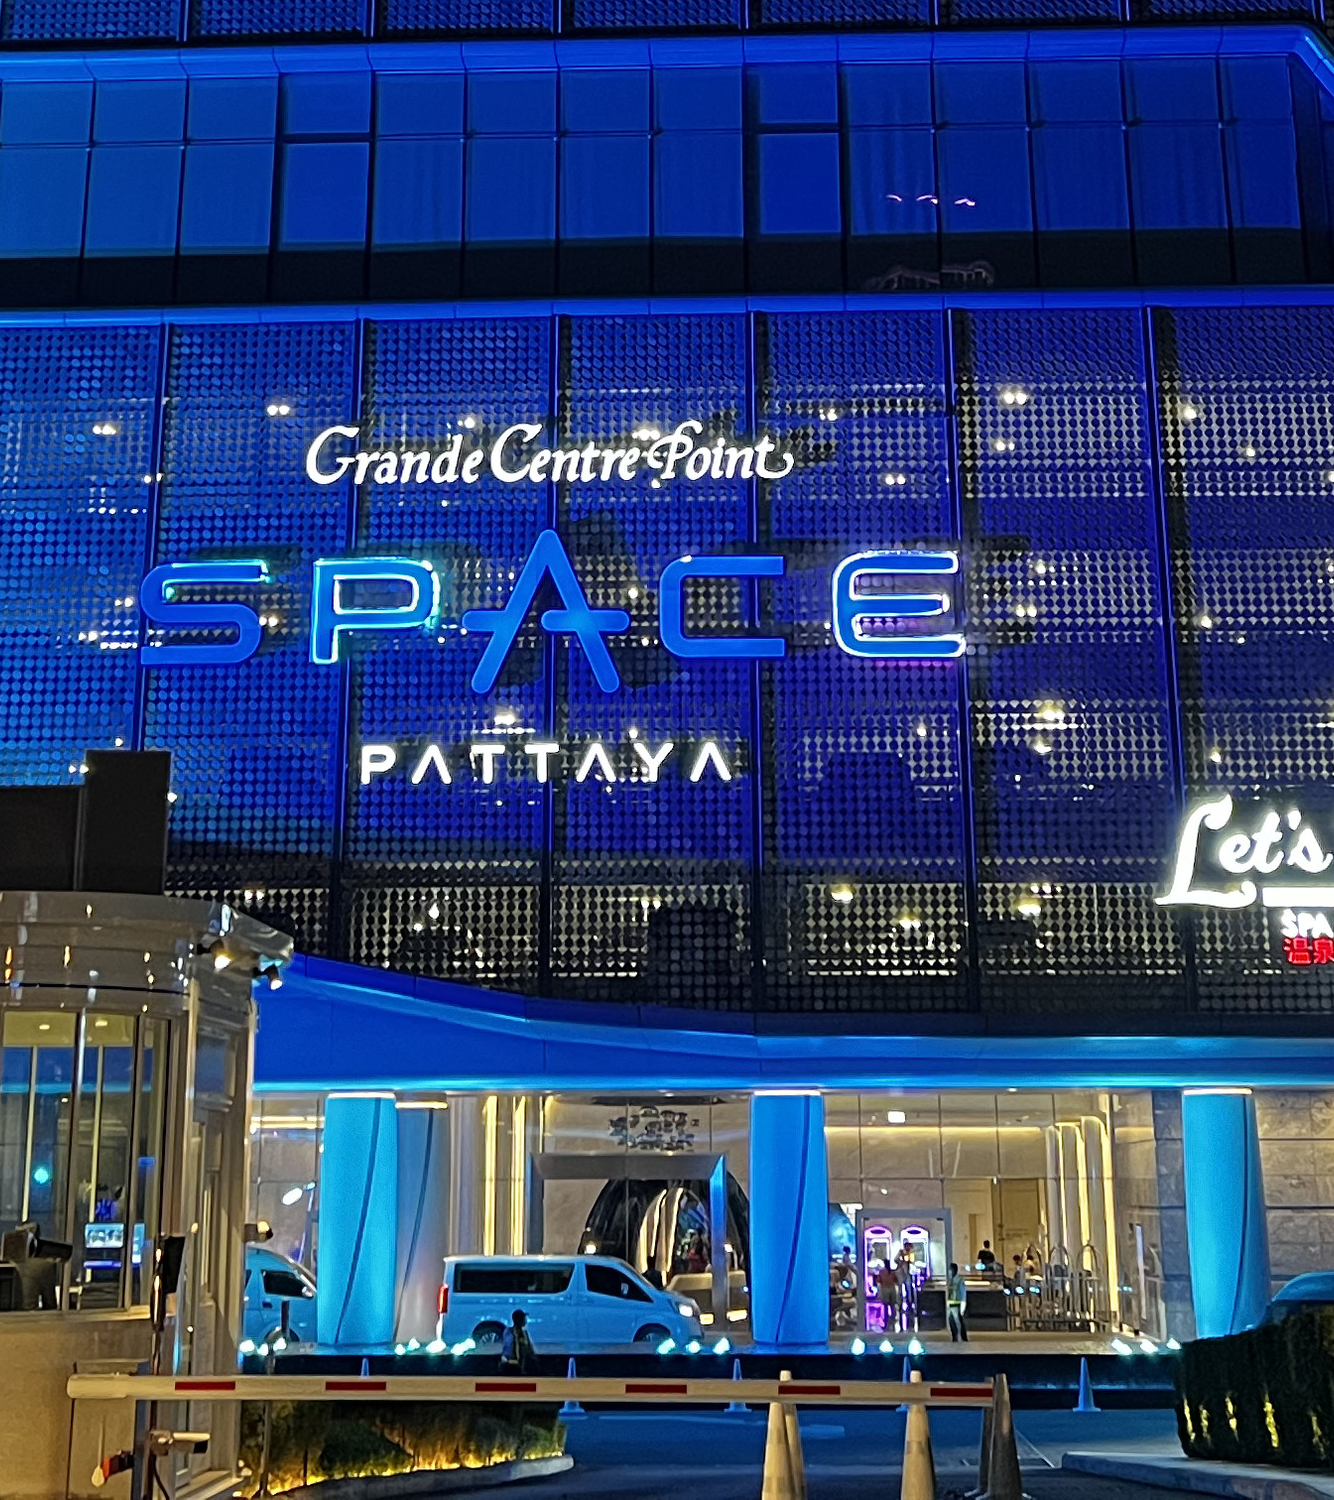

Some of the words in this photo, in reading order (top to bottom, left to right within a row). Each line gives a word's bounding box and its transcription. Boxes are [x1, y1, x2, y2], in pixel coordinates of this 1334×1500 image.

[306, 425, 480, 485] Grande
[491, 423, 639, 483] Centre
[646, 420, 794, 480] Point
[139, 528, 966, 693] SPACE
[361, 743, 732, 784] PATTAYA
[1154, 793, 1334, 907] Let's
[1281, 909, 1334, 938] SPA
